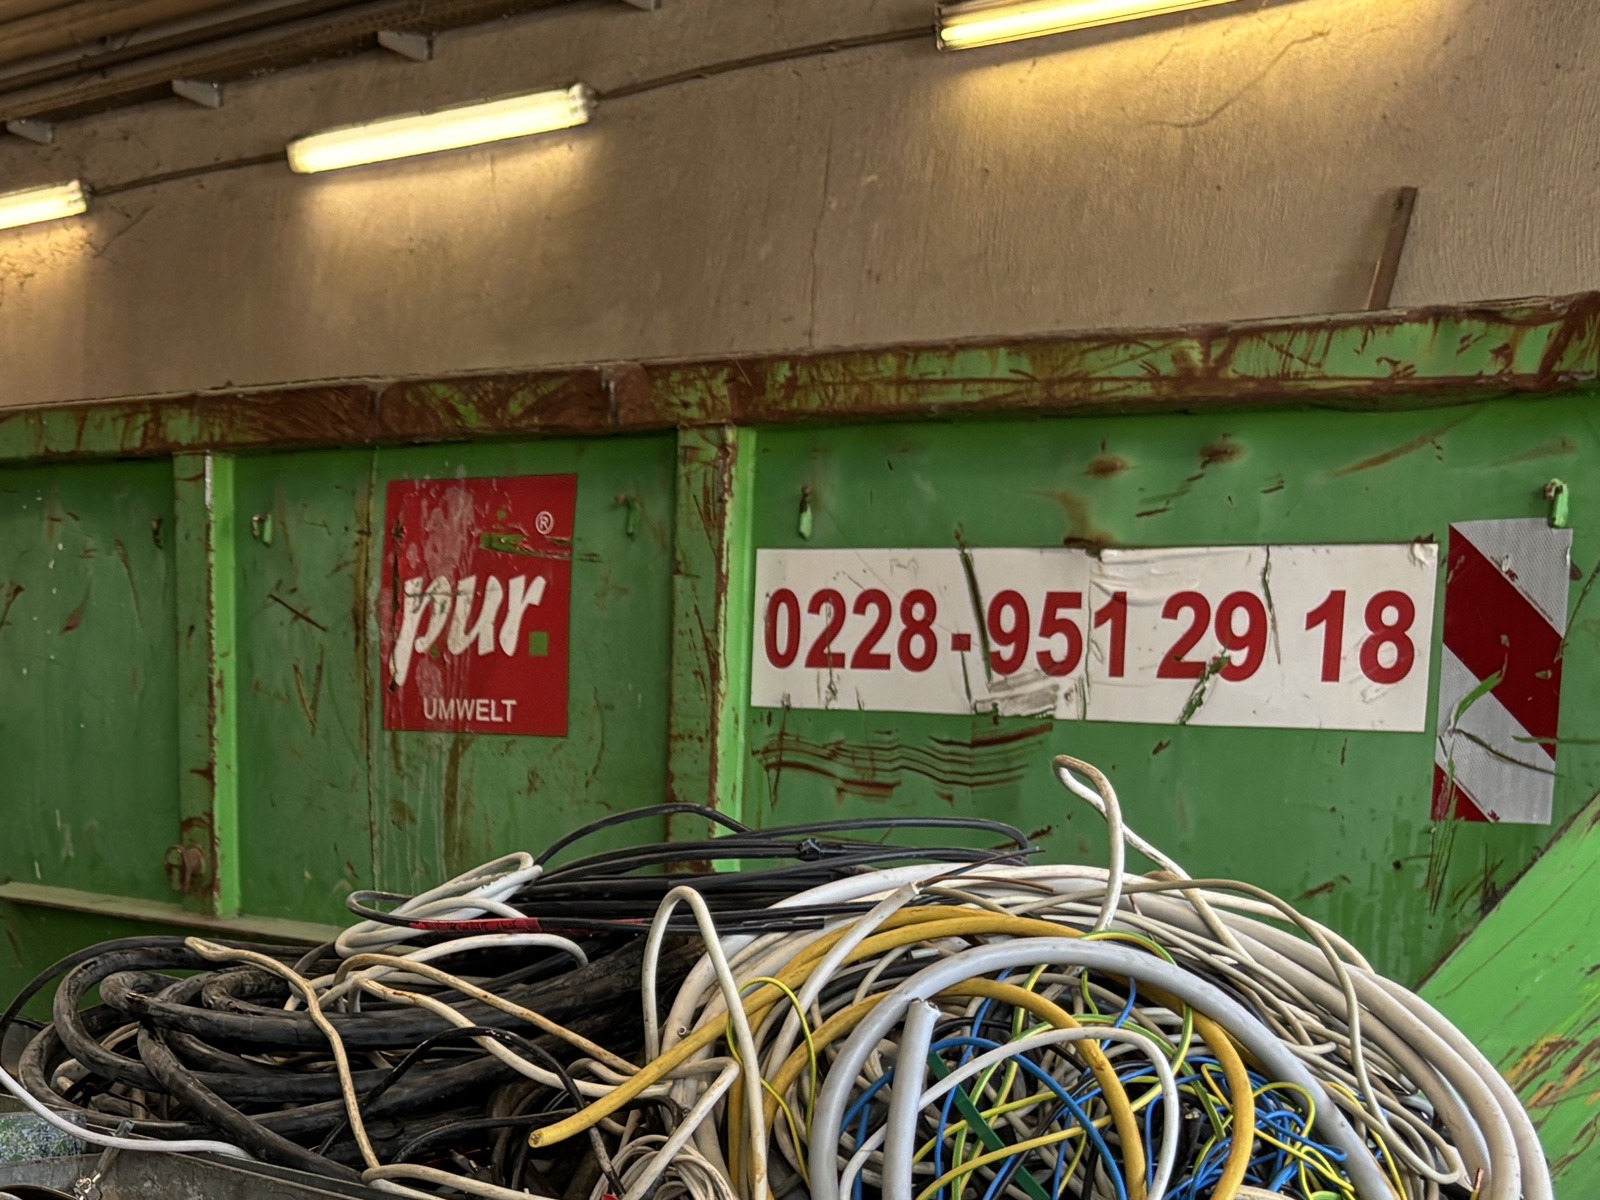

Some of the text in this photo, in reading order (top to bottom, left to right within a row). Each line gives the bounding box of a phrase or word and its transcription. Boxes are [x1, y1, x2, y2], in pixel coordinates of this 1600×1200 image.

[1157, 591, 1267, 682] 29
[1305, 589, 1415, 684] 18
[423, 698, 517, 723] UMWELT
